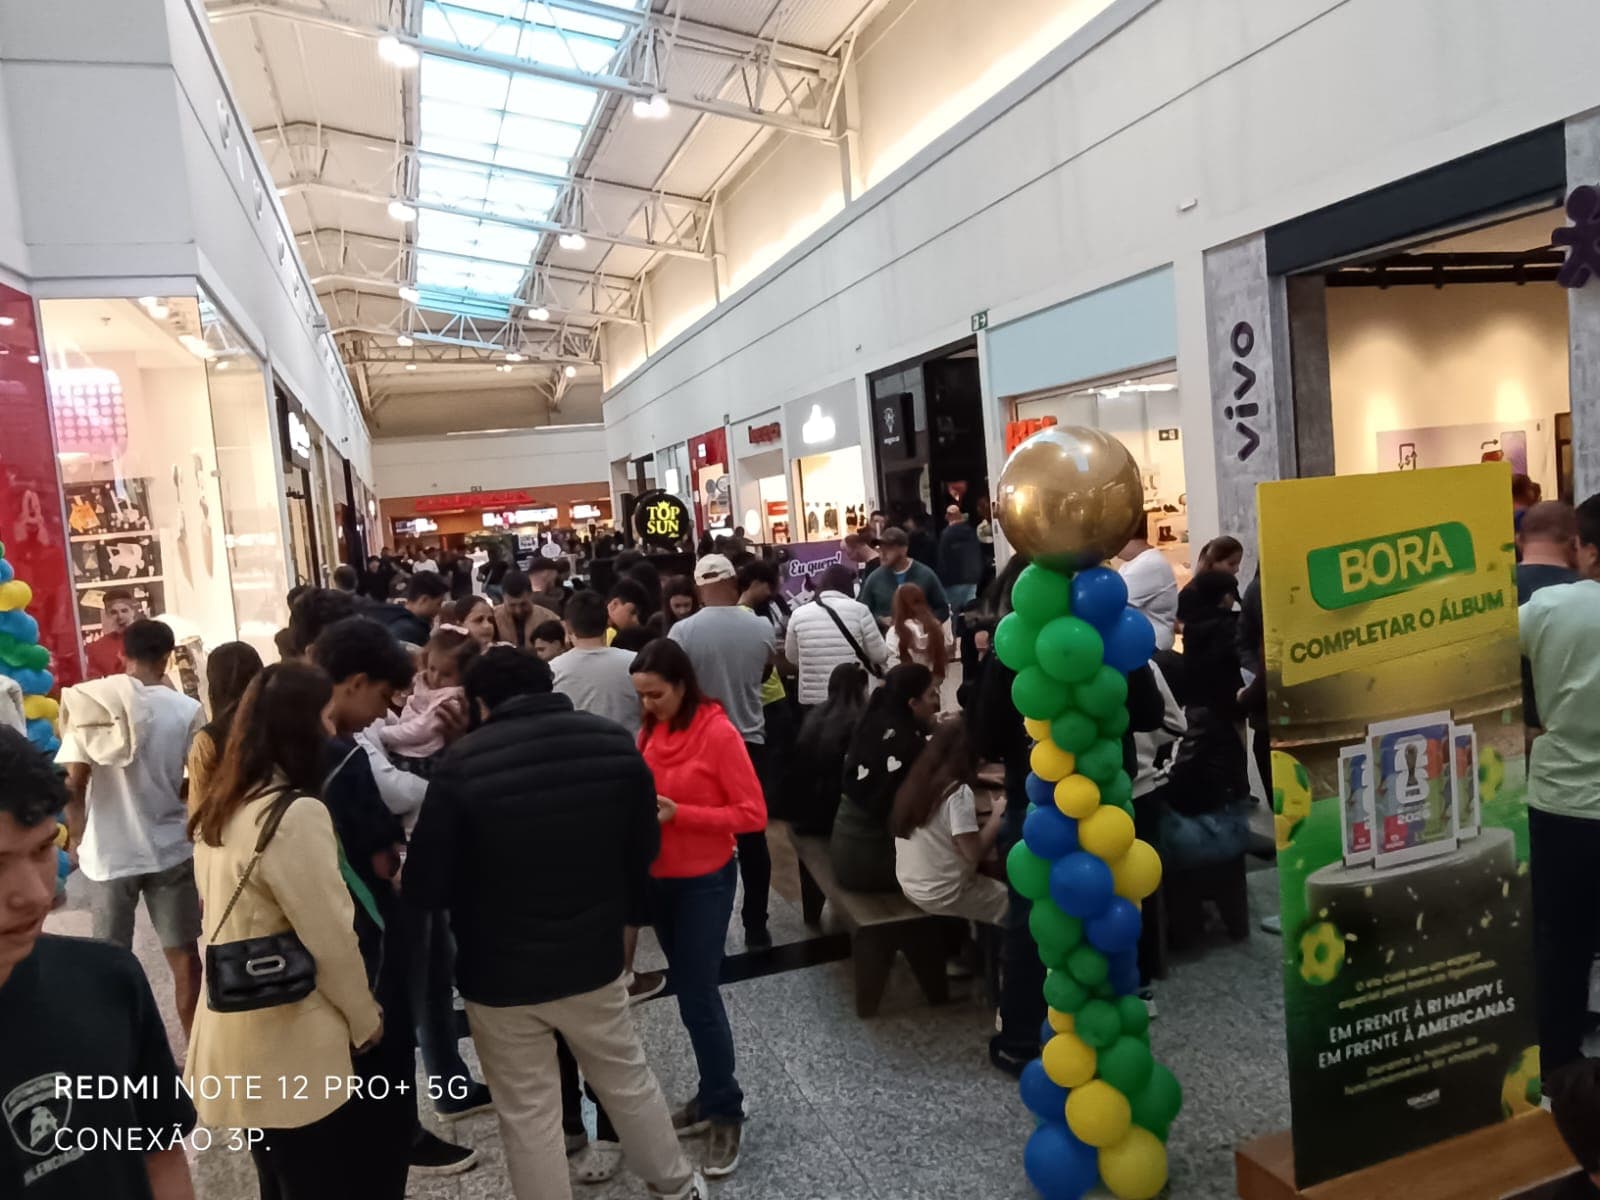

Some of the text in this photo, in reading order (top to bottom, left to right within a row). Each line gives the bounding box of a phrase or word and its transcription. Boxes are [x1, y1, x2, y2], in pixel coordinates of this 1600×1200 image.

[1224, 320, 1260, 462] vivo
[646, 505, 681, 520] TOP
[646, 520, 680, 534] SUN
[1338, 531, 1454, 595] BORA
[1290, 589, 1504, 663] COMPLETAR O ÁLBUM
[1318, 1051, 1341, 1069] EM
[1345, 1033, 1399, 1062] FRENTE
[1417, 996, 1517, 1039] AMERICANAS
[1329, 1025, 1352, 1044] EM
[1356, 1006, 1409, 1036] FRENTE
[1444, 985, 1493, 1011] HAPPY
